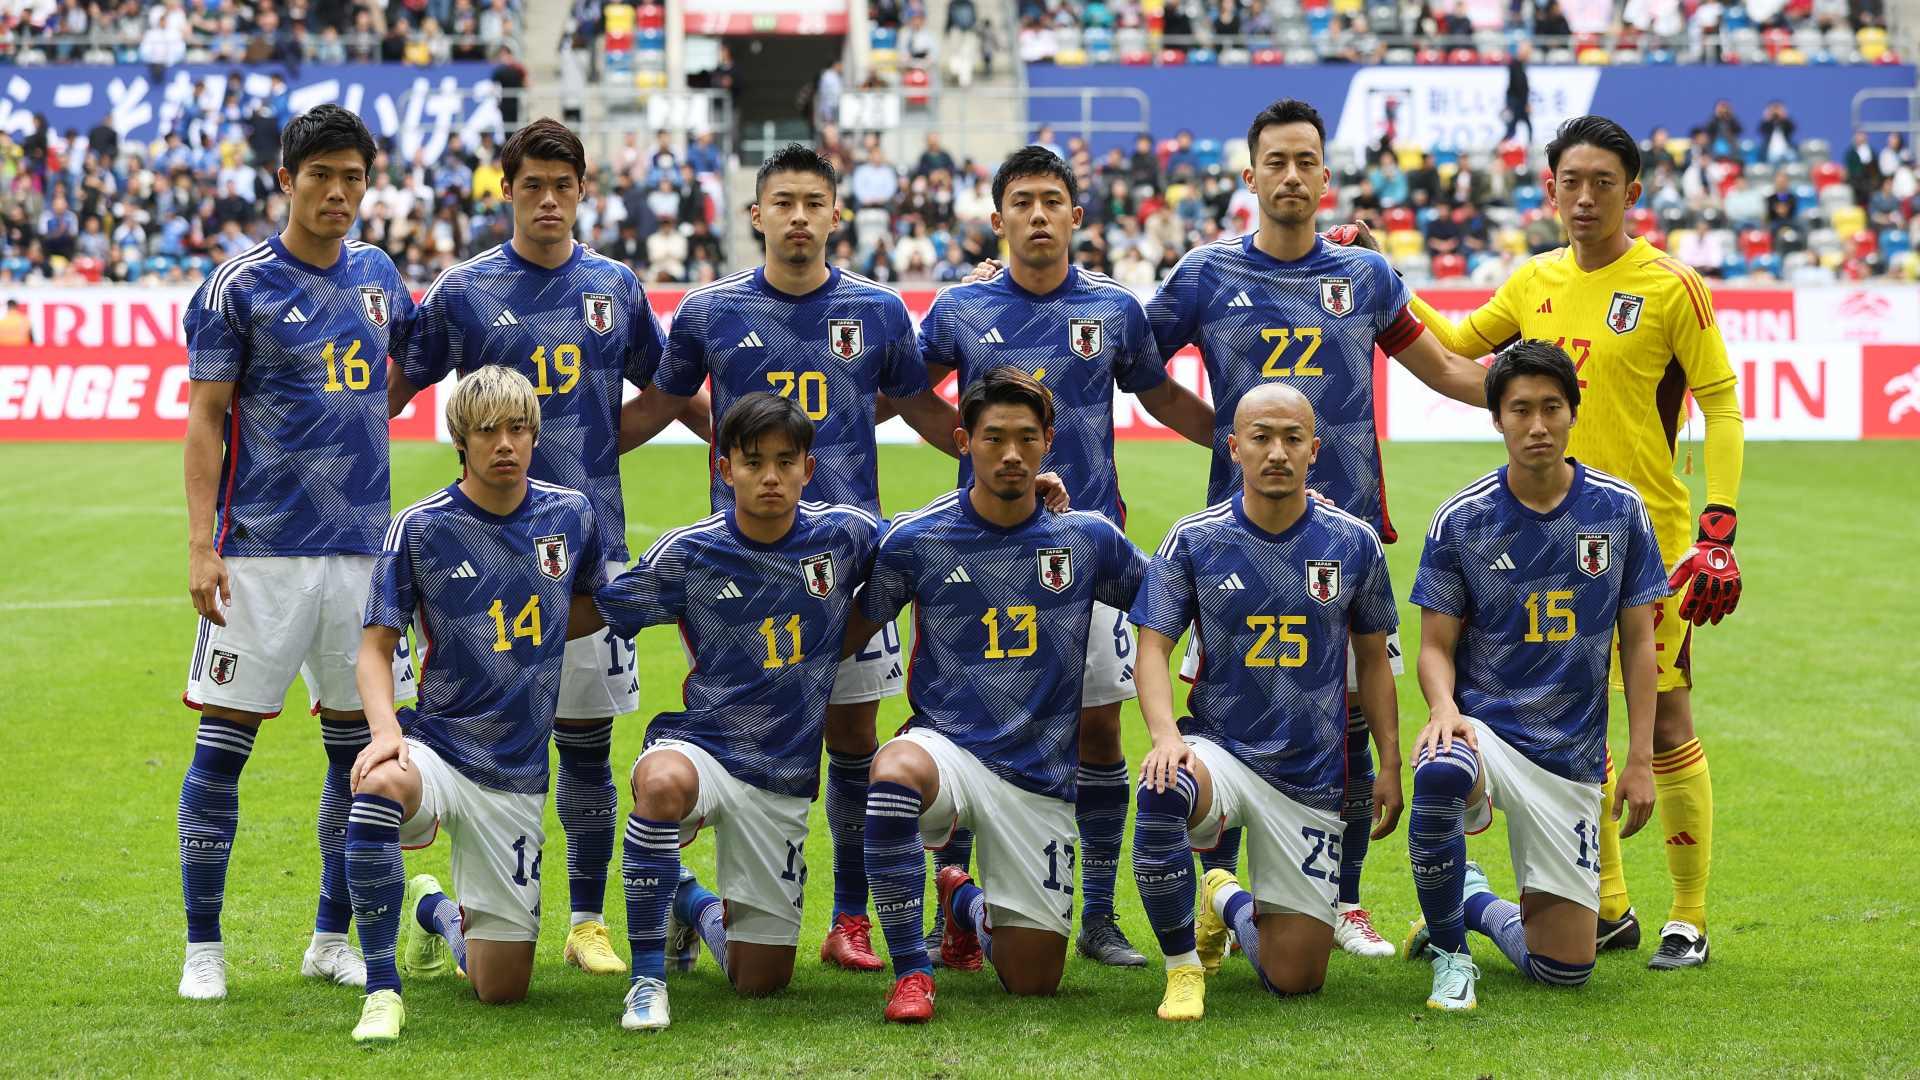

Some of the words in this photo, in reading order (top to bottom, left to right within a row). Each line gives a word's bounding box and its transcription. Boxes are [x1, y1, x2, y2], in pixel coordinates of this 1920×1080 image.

[321, 340, 370, 392] 16
[530, 344, 581, 396] 19
[1261, 327, 1323, 378] 22
[488, 595, 542, 652] 14
[758, 614, 806, 669] 11
[981, 605, 1038, 659] 13
[1245, 615, 1308, 667] 25
[1523, 591, 1577, 643] 15
